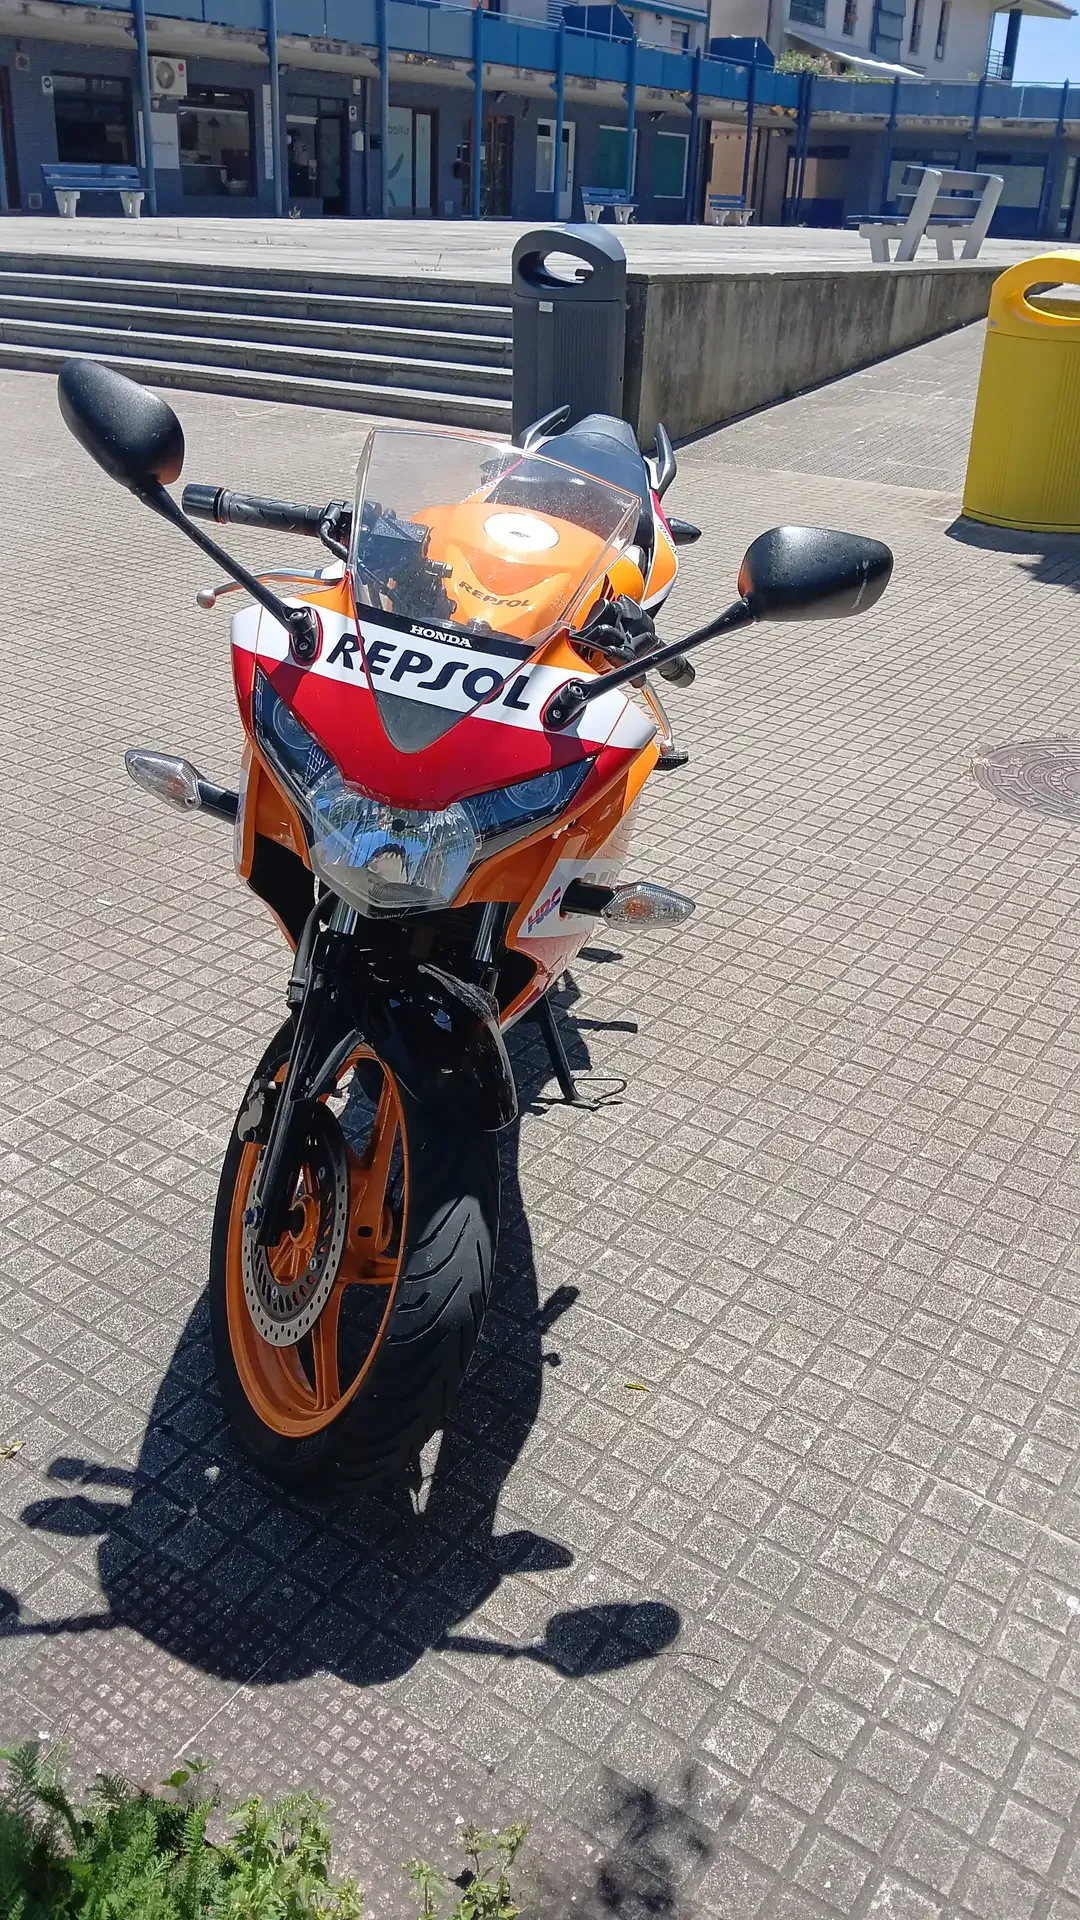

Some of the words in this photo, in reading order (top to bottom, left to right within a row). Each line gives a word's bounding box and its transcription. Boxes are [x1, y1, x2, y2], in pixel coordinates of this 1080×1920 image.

[459, 581, 530, 607] REPSOL
[410, 625, 472, 648] HONDA
[326, 632, 531, 711] REPSOL
[527, 886, 561, 934] HRC
